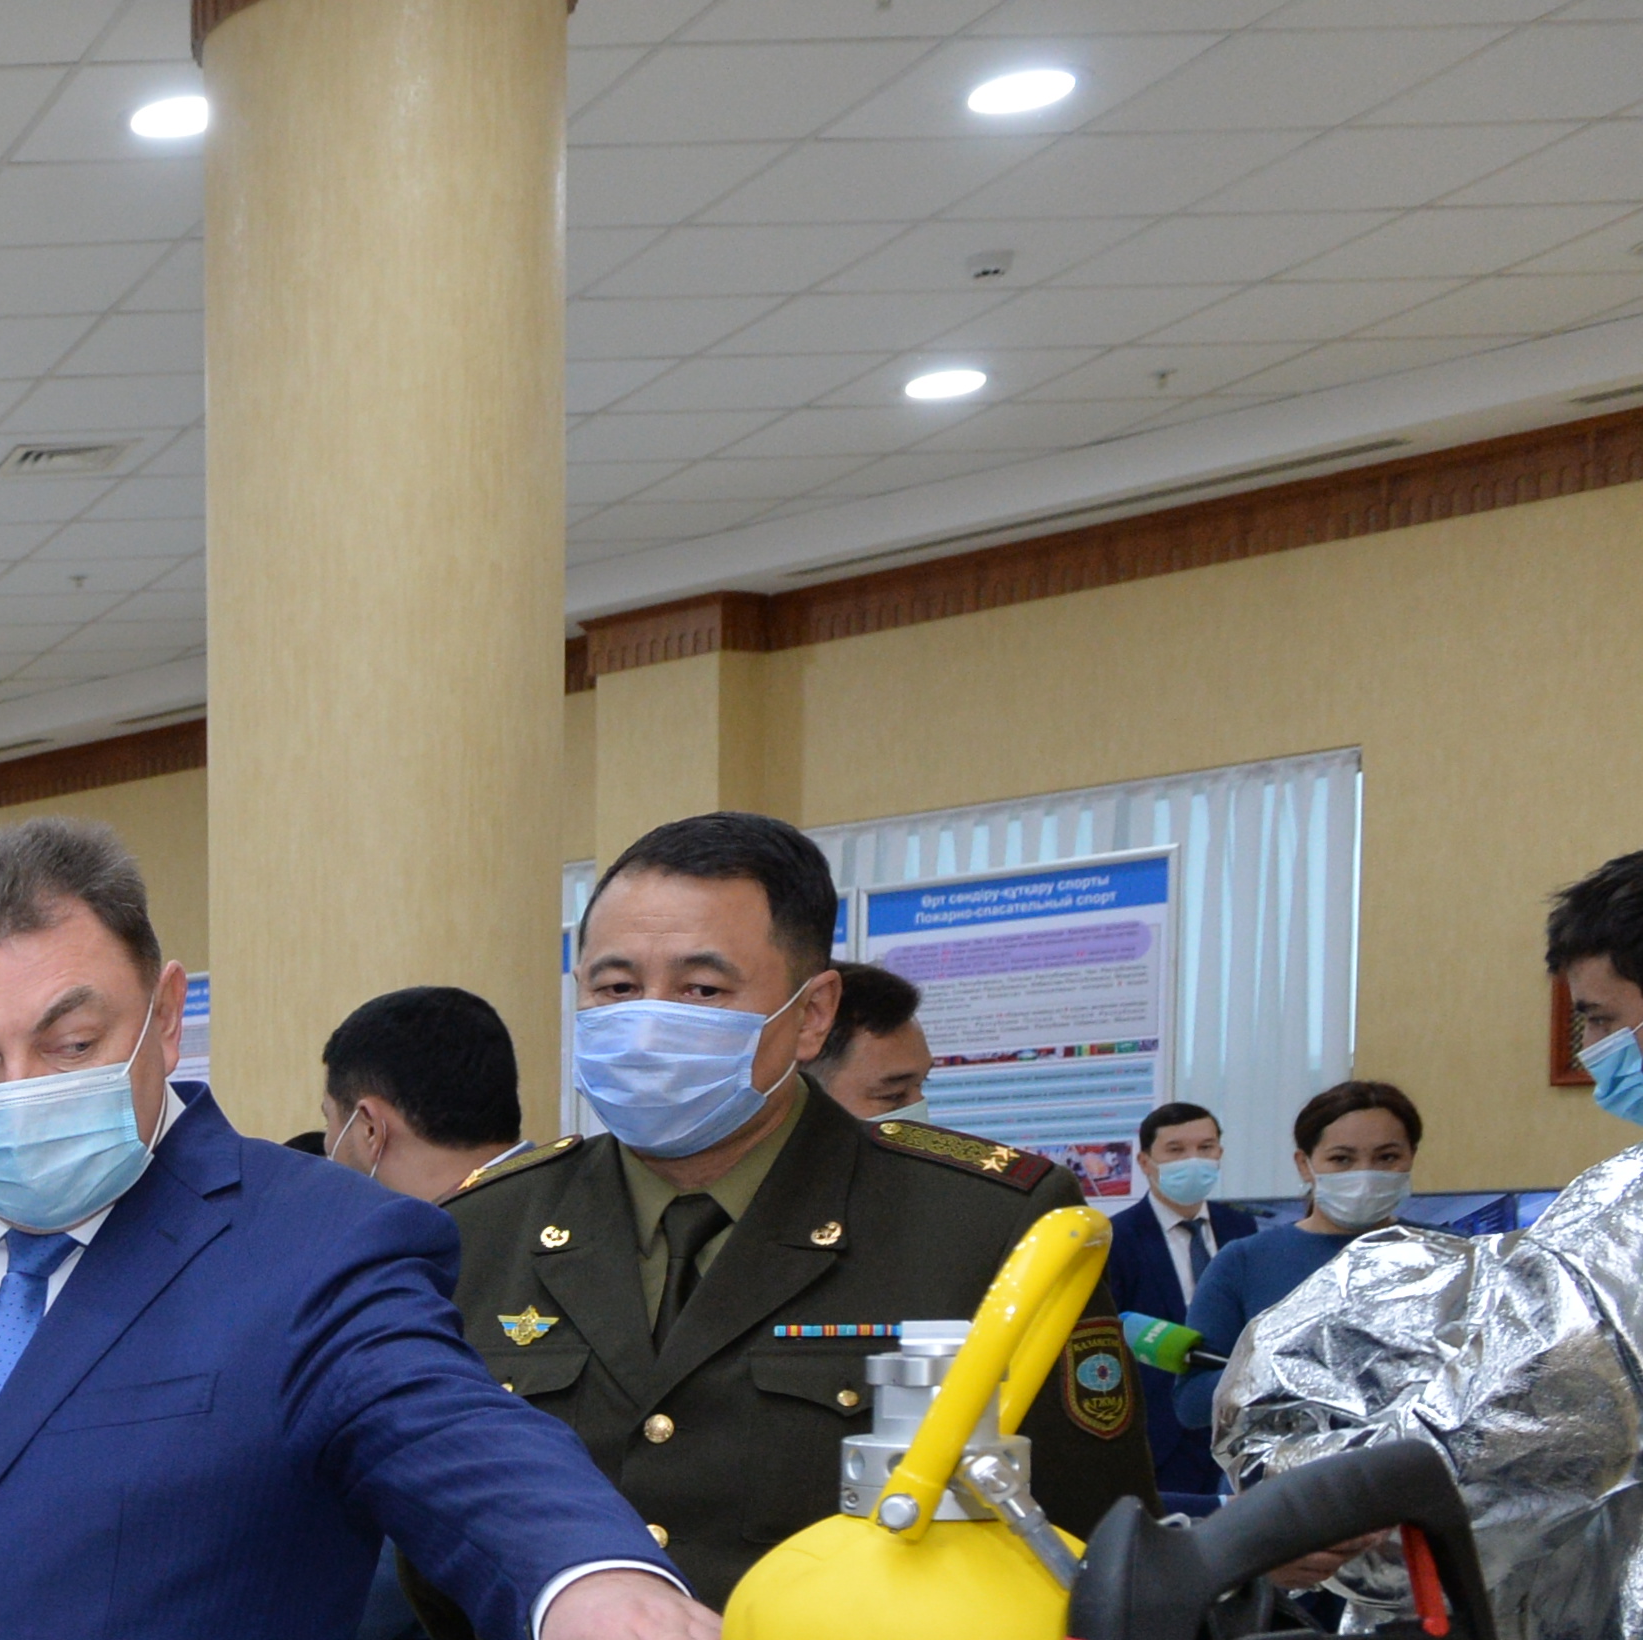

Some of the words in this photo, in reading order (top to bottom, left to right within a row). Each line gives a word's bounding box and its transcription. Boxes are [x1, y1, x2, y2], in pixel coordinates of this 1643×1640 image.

[1058, 874, 1110, 891] спорты
[915, 897, 1073, 925] Пожарно-спасательный
[1076, 890, 1118, 908] спорт
